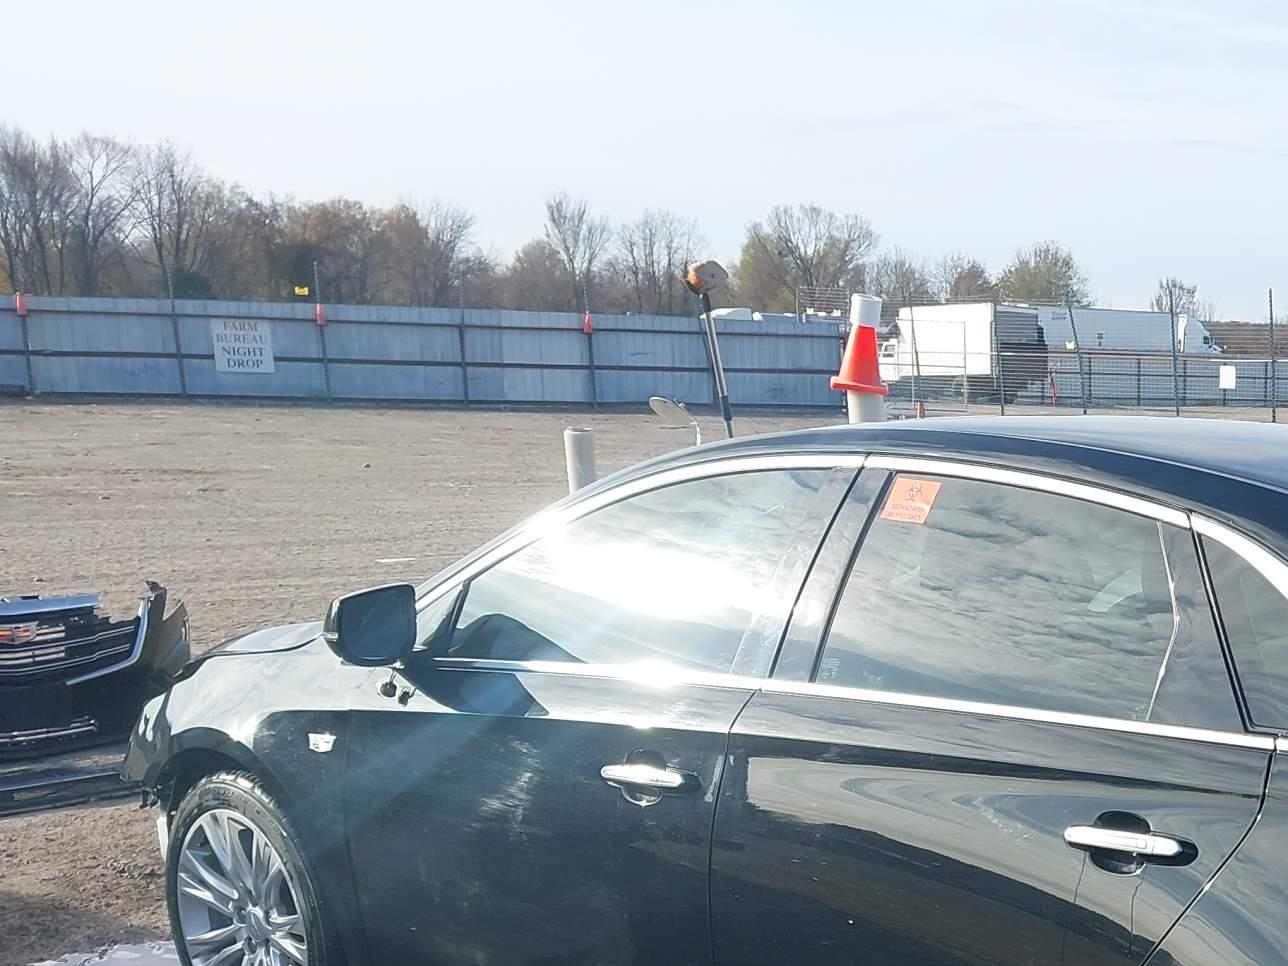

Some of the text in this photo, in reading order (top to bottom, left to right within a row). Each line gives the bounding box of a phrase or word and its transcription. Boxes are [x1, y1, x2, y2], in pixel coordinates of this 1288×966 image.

[223, 321, 258, 333] FARM
[216, 332, 267, 345] BUREAU
[222, 346, 265, 358] NIGHT
[226, 358, 264, 369] DROP
